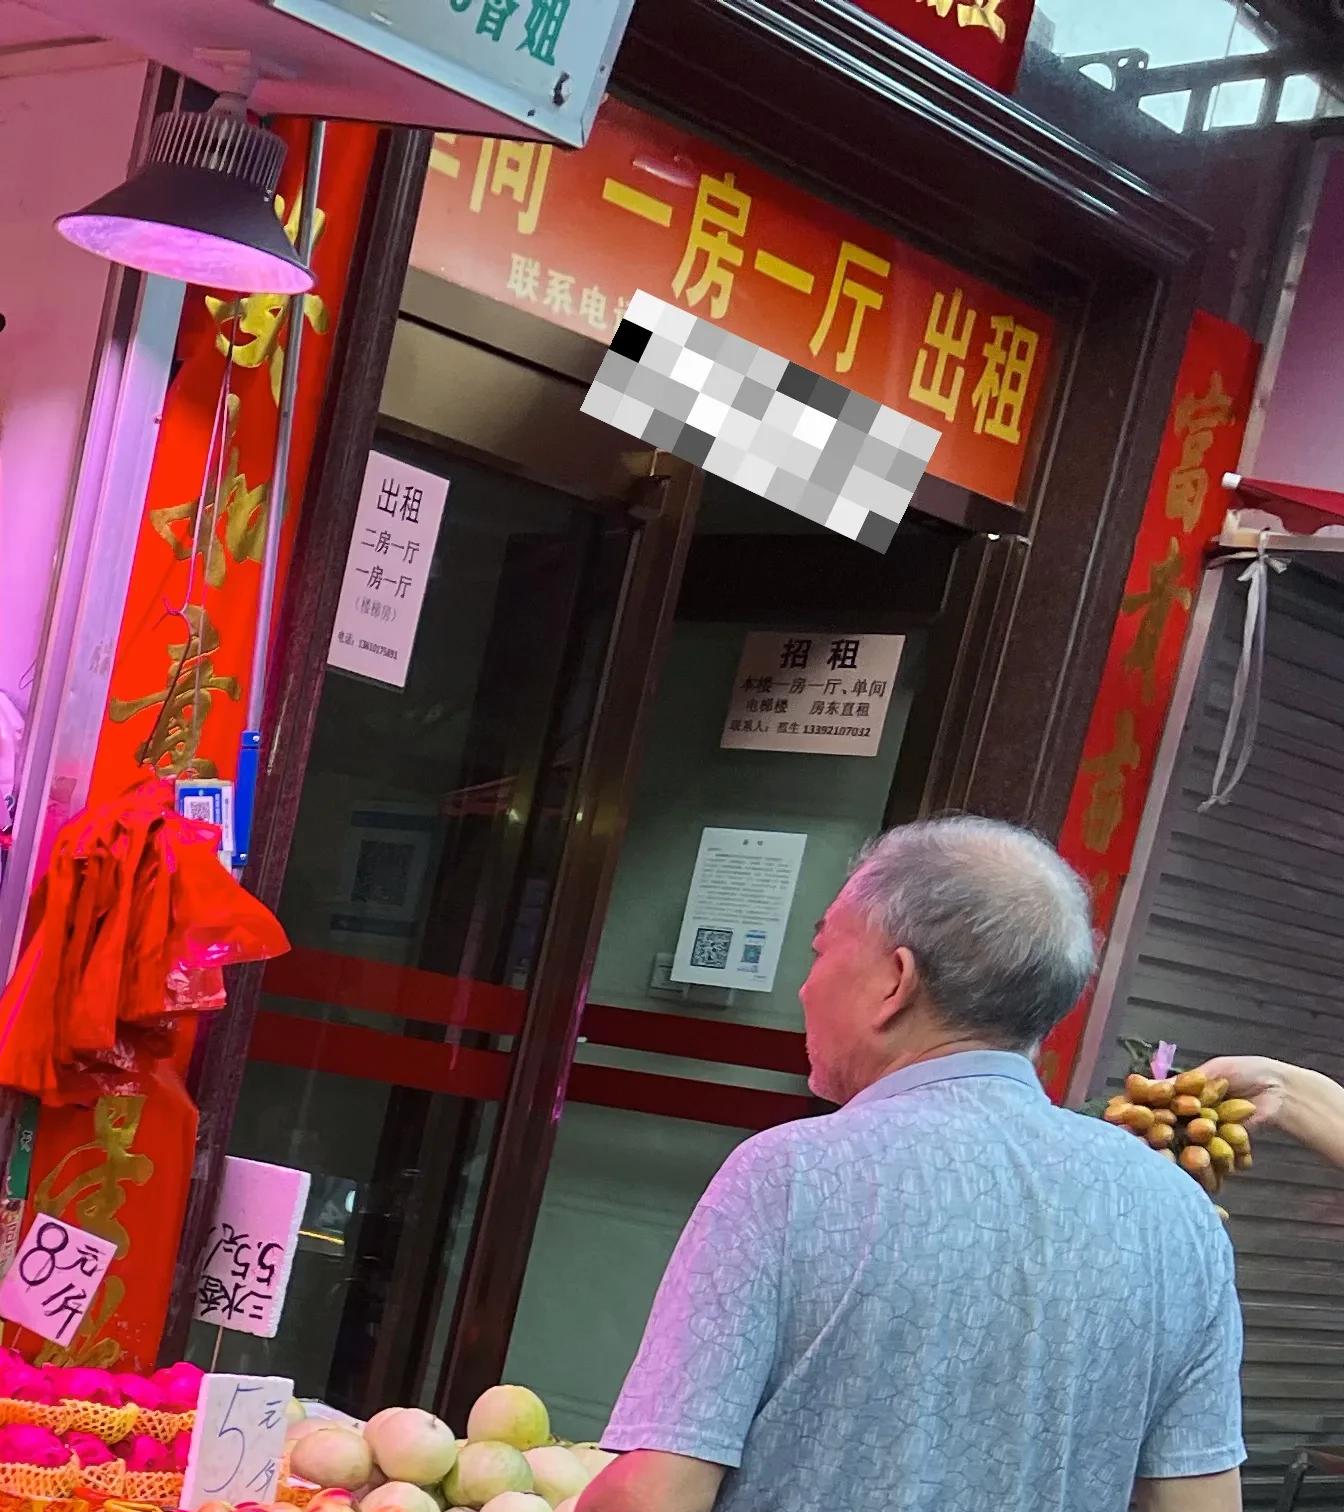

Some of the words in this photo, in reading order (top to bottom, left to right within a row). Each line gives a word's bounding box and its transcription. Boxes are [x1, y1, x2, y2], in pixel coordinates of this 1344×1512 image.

[602, 172, 891, 374] 一房一厅
[908, 287, 1039, 445] 出租
[376, 477, 424, 524] 出租
[360, 528, 420, 564] 二房一厅
[355, 565, 413, 599] 一房一厅
[779, 639, 860, 670] 招租
